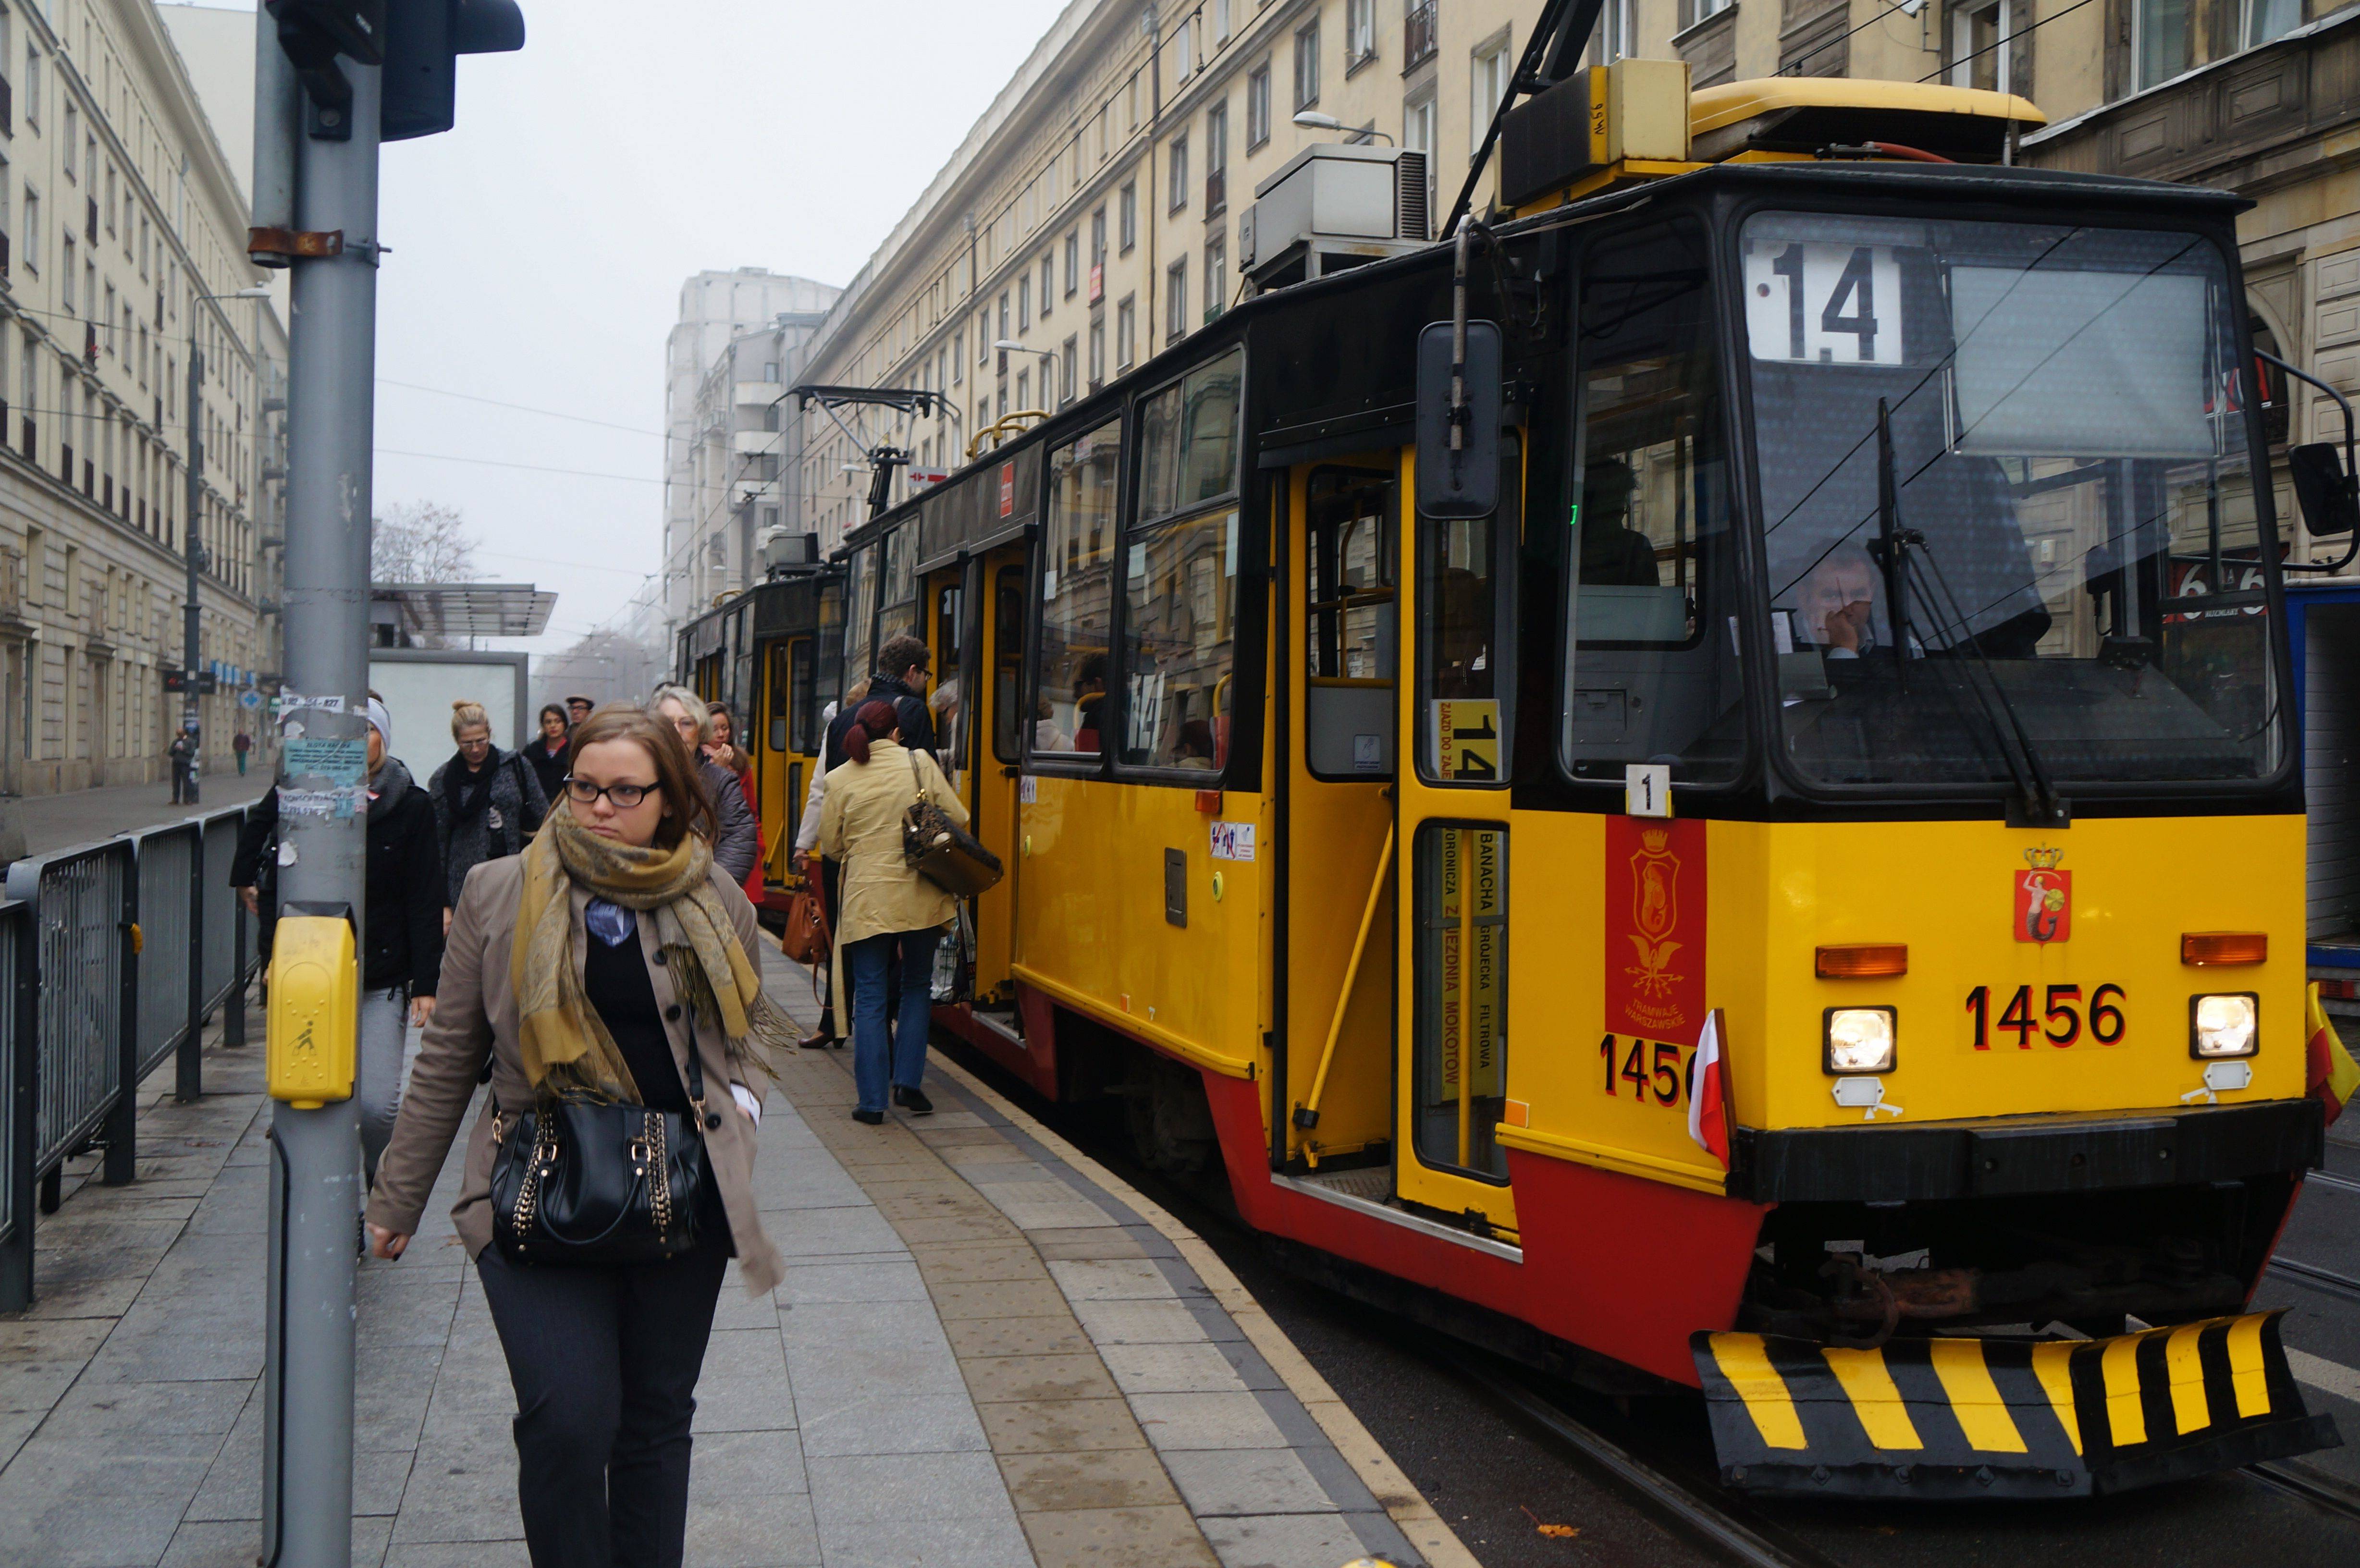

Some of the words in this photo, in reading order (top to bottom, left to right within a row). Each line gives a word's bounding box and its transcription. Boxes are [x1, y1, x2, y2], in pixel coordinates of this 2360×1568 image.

[1773, 243, 1878, 361] 14
[1441, 702, 1451, 732] ZJAZD
[1442, 736, 1451, 751] DO
[1453, 714, 1497, 780] 14
[1641, 772, 1651, 810] 1
[1480, 833, 1494, 910] BANACHA
[1445, 905, 1459, 992] ZJEZDNIA
[1479, 925, 1492, 990] GRÓJECKA
[1480, 1004, 1489, 1069] FILTROWA
[1625, 1004, 1685, 1030] WARSZAWSKIE
[1634, 998, 1679, 1018] TRAMWAJE
[1966, 982, 2126, 1051] 1456
[1600, 1033, 1697, 1108] 145
